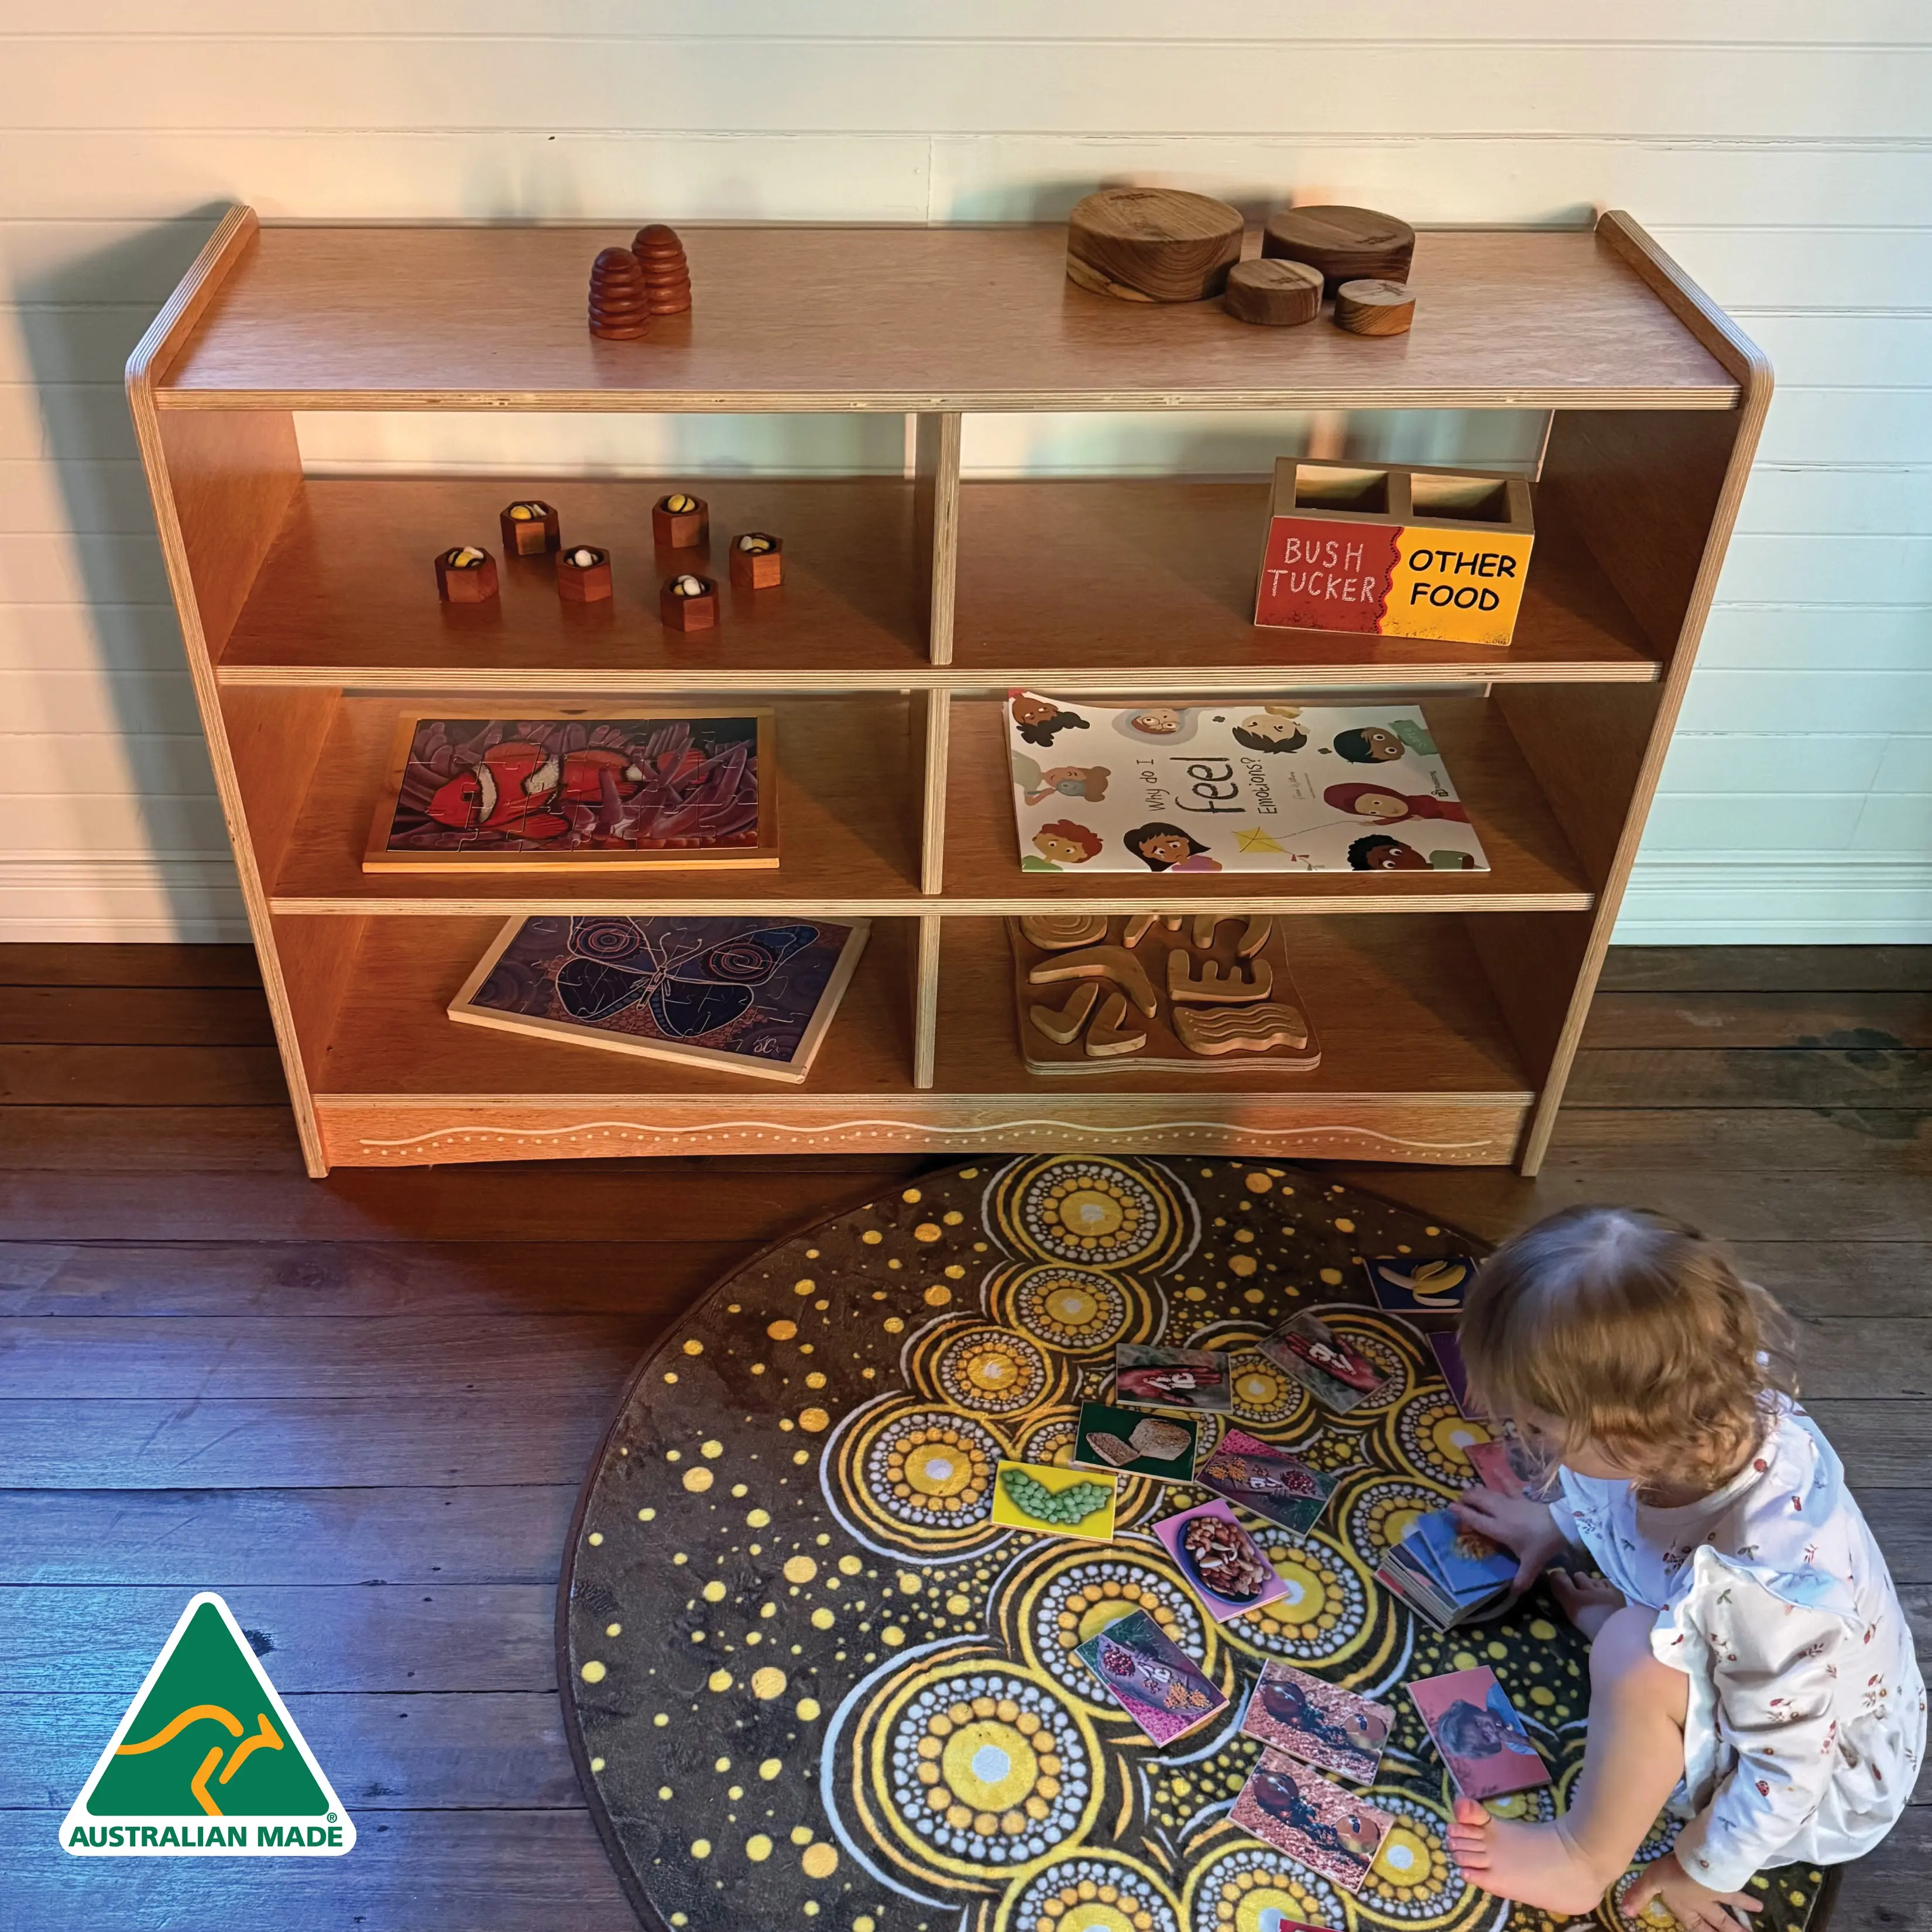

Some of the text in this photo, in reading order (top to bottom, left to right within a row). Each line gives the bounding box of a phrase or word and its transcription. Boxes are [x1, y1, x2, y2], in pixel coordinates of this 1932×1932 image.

[1284, 537, 1364, 573] BUSH
[1409, 549, 1516, 578] OTHER
[1267, 569, 1376, 604] TUCKER
[1409, 582, 1500, 612] FOOD
[1139, 770, 1158, 784] do
[1169, 757, 1247, 814] feel
[1240, 757, 1278, 814] Emotions?
[1145, 788, 1171, 812] Why
